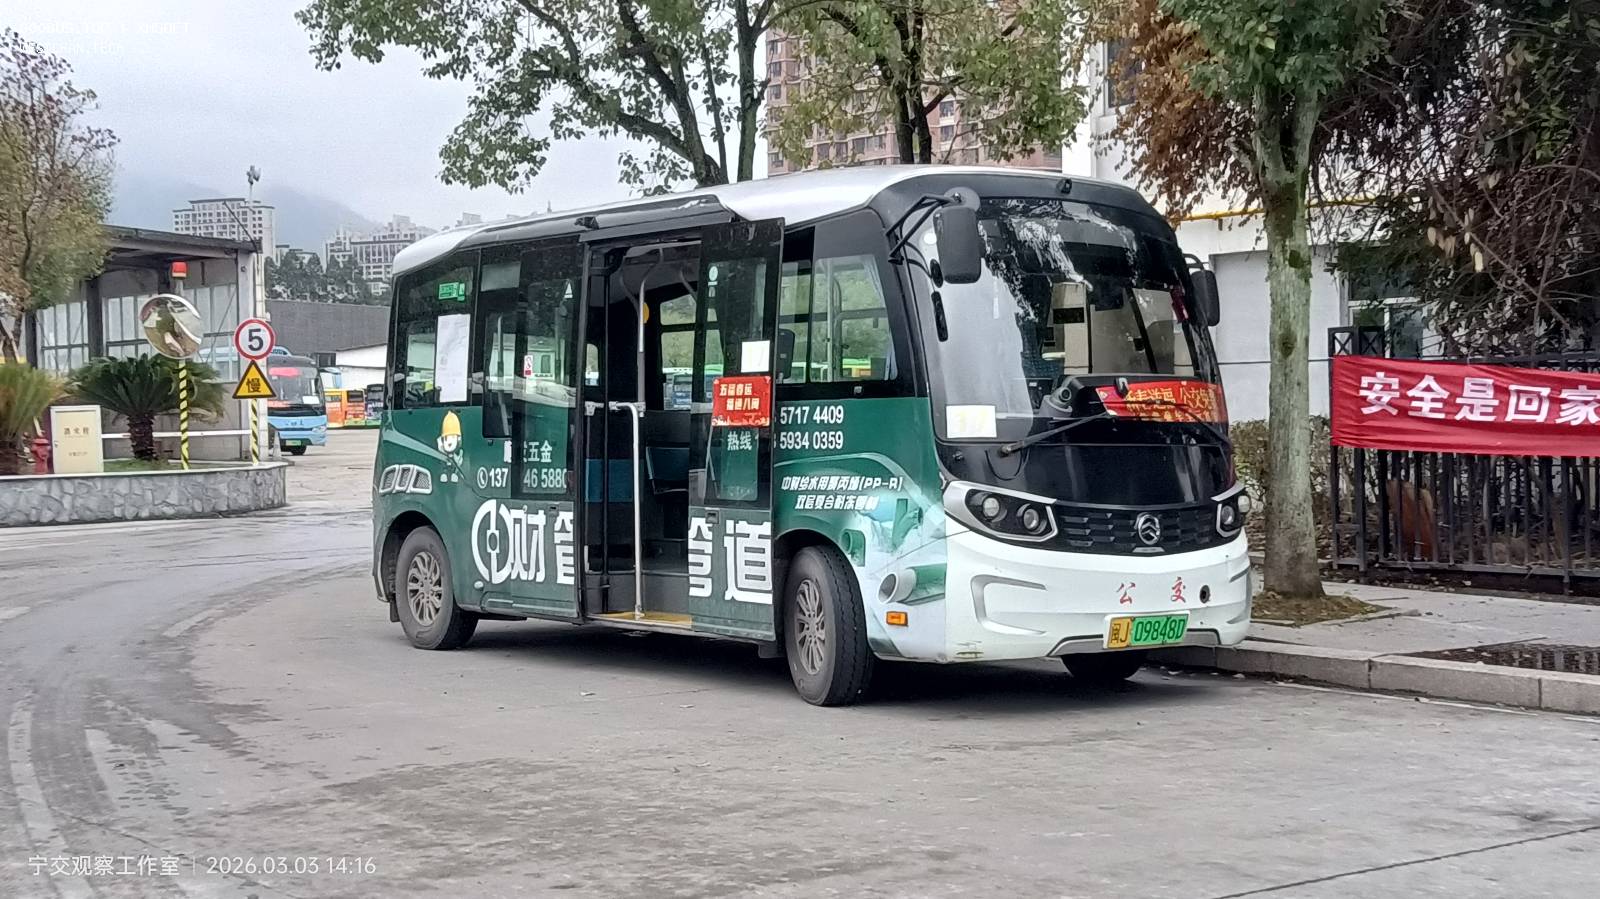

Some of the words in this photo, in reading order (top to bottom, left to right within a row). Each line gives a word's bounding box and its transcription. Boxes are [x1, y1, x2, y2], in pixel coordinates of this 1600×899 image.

[248, 328, 264, 351] 5
[246, 377, 262, 393] 慢
[1358, 371, 1600, 426] 安全是回家
[780, 406, 810, 424] 5717
[813, 405, 844, 424] 4409
[727, 431, 752, 450] 热线
[780, 431, 809, 450] 5934
[813, 431, 844, 450] 0359
[489, 467, 509, 488] 137
